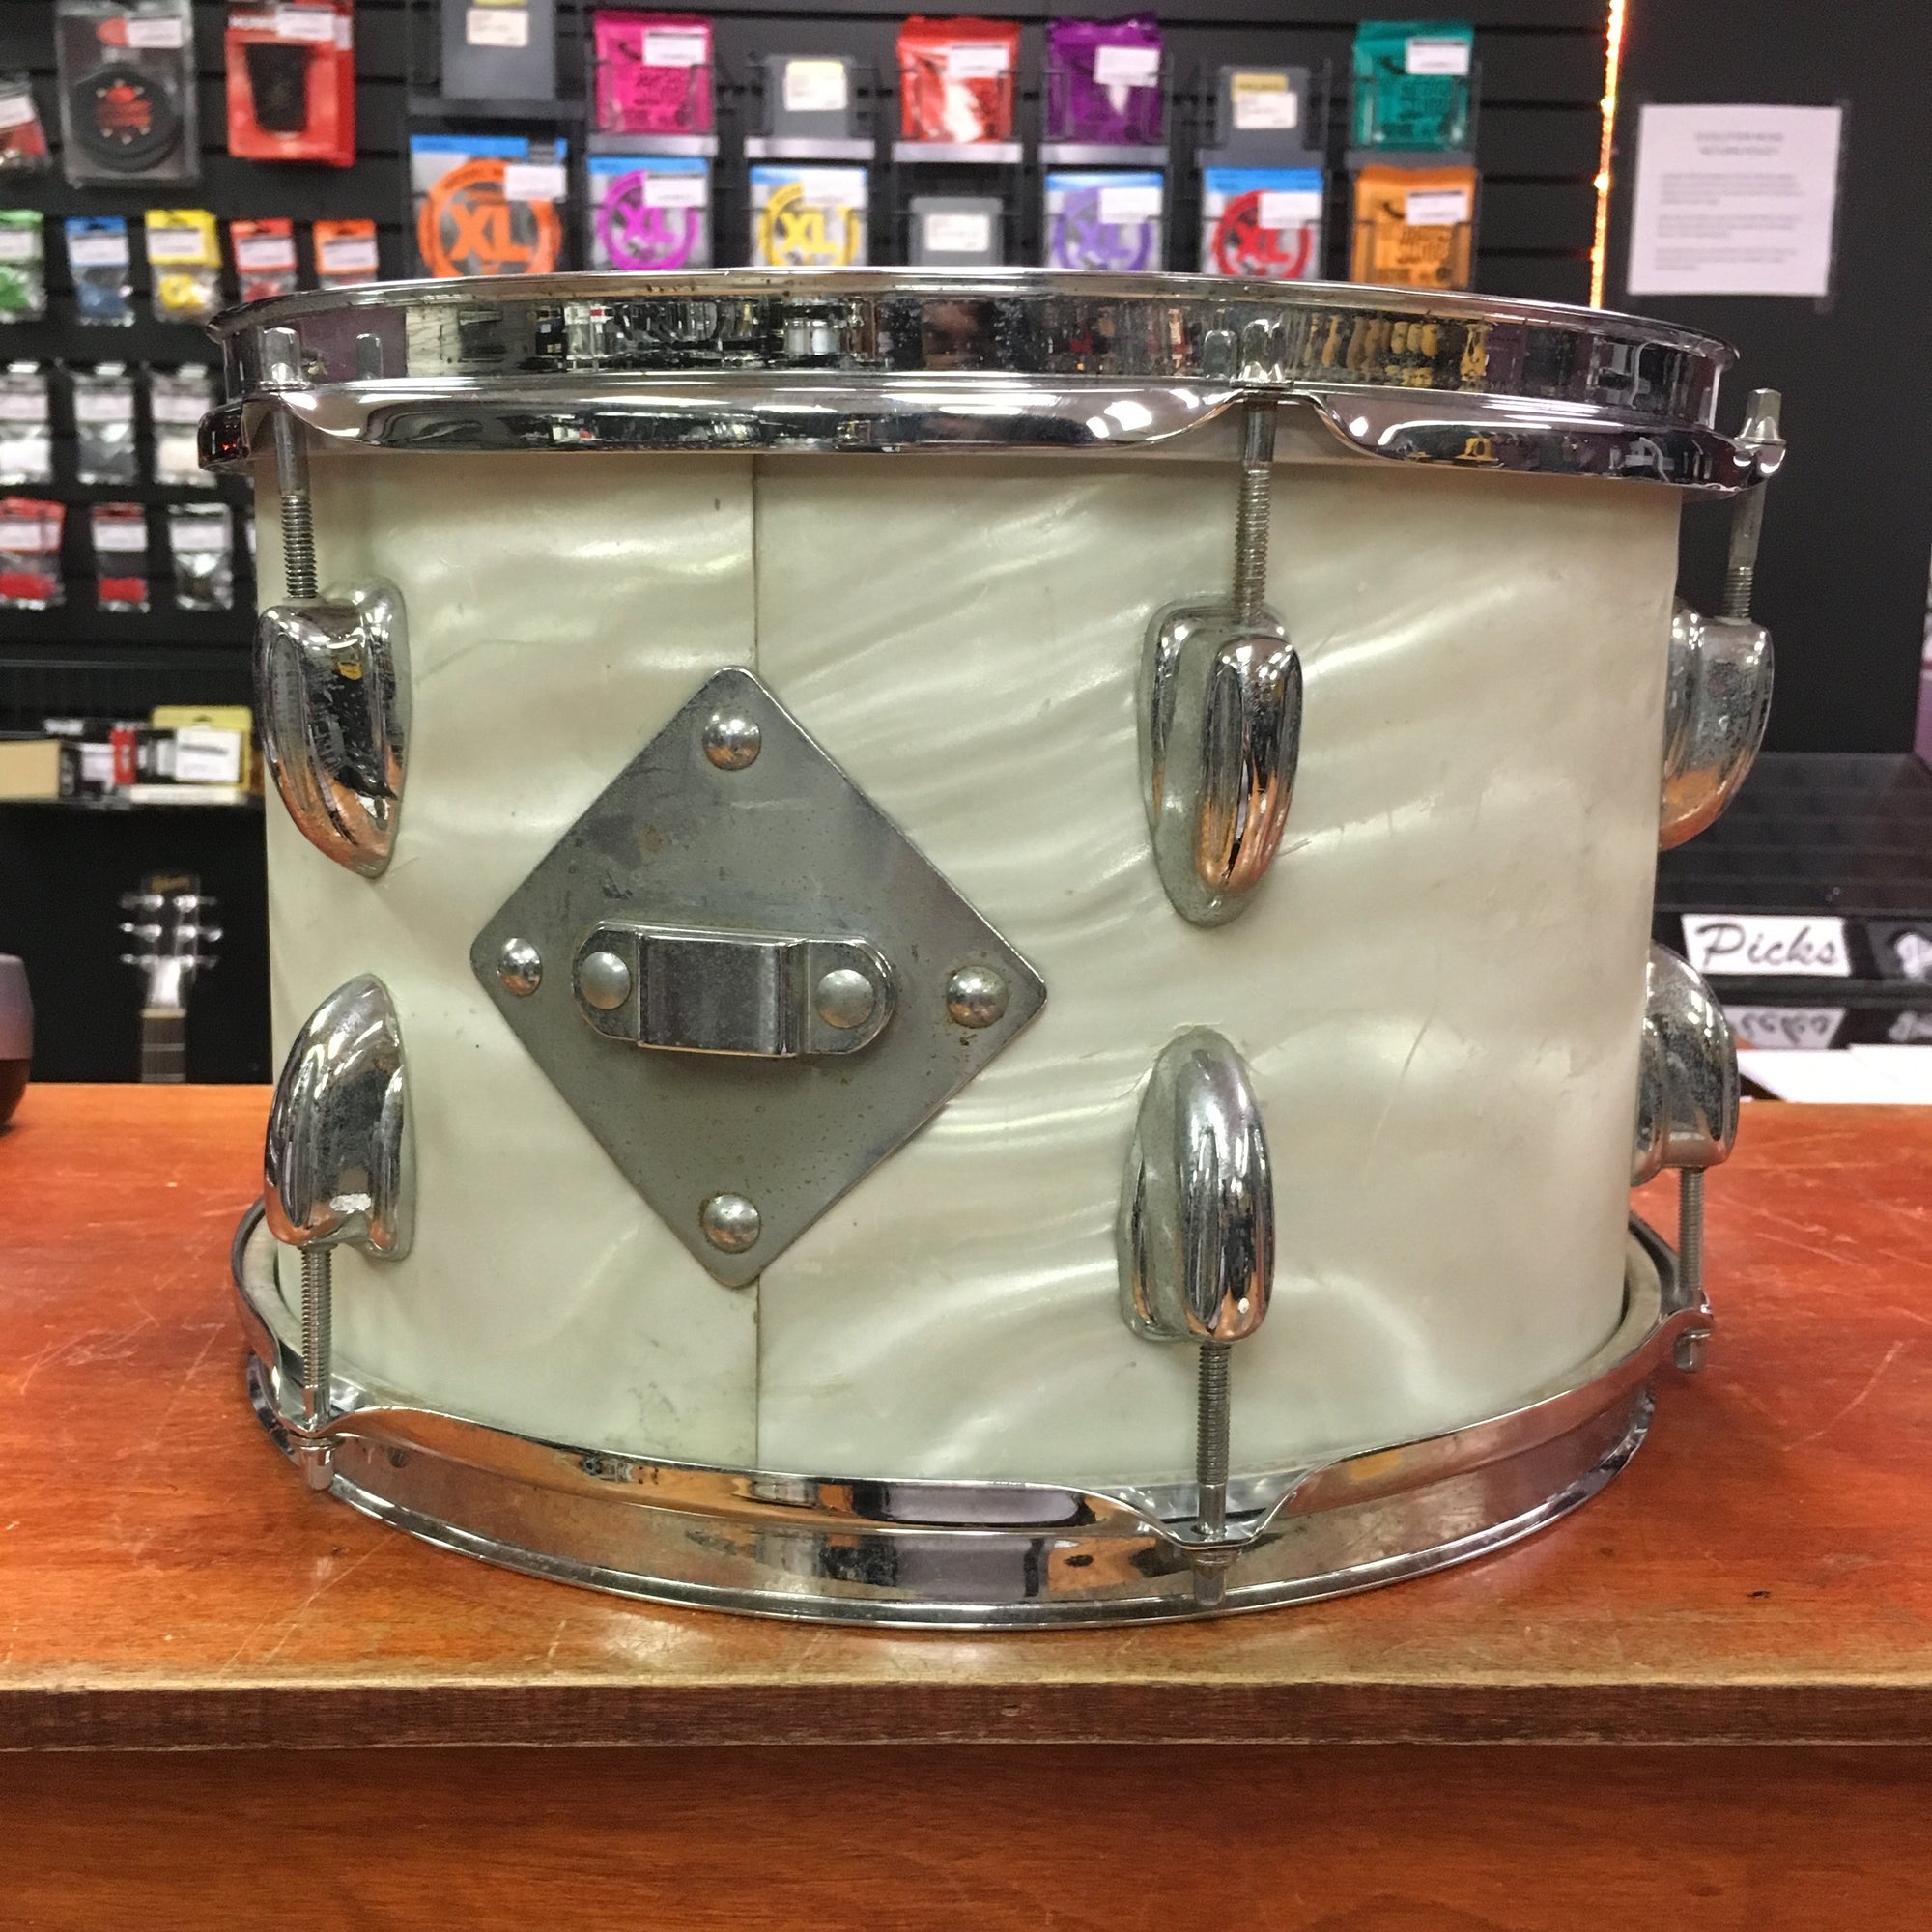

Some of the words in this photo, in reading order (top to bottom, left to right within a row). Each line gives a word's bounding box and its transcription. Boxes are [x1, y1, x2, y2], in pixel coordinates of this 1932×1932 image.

[449, 204, 531, 263] XL
[618, 203, 676, 243] XL
[781, 212, 838, 253] XL
[1076, 221, 1133, 259] XL
[1236, 224, 1290, 264] XL
[1696, 923, 1836, 967] Picks
